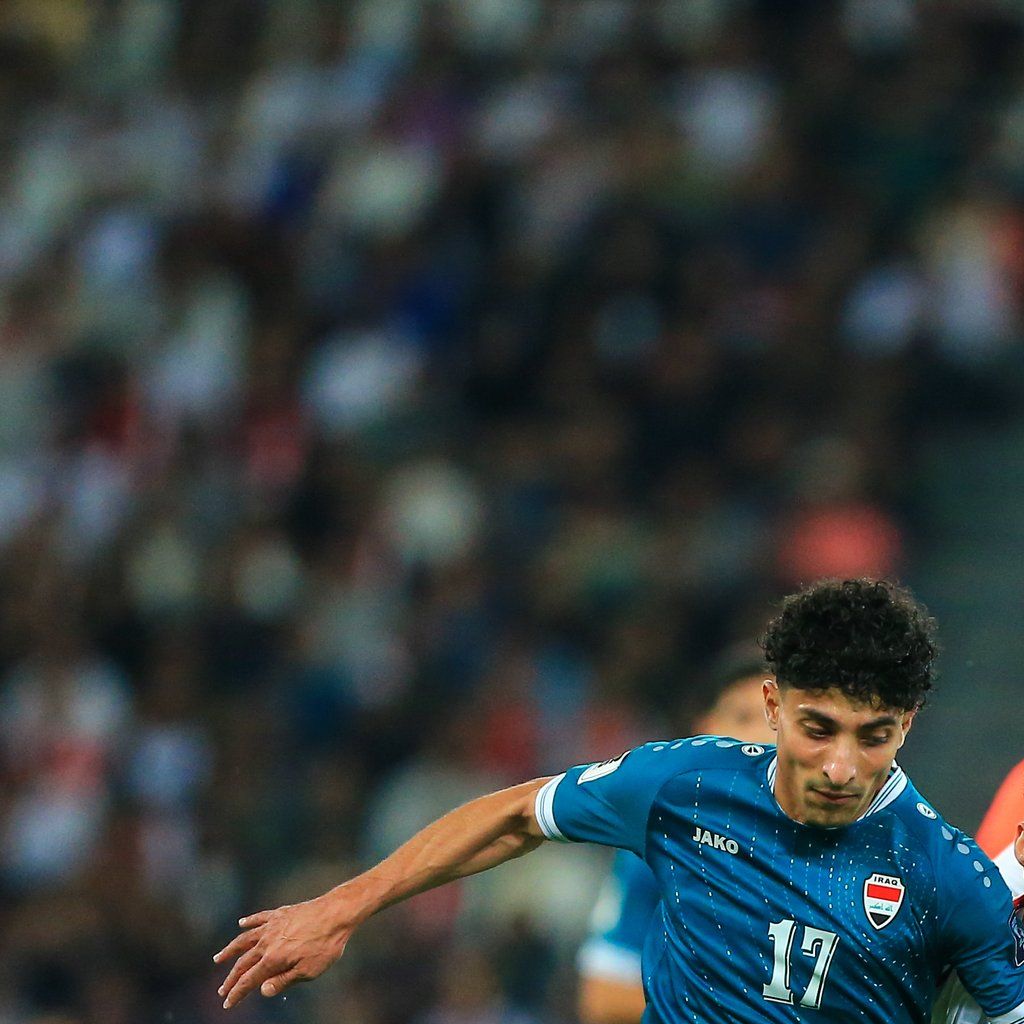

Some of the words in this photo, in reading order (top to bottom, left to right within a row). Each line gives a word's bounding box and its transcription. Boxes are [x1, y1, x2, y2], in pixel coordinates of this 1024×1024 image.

[692, 826, 739, 855] JAKO
[873, 876, 898, 886] IRAQ
[762, 918, 840, 1010] 17
